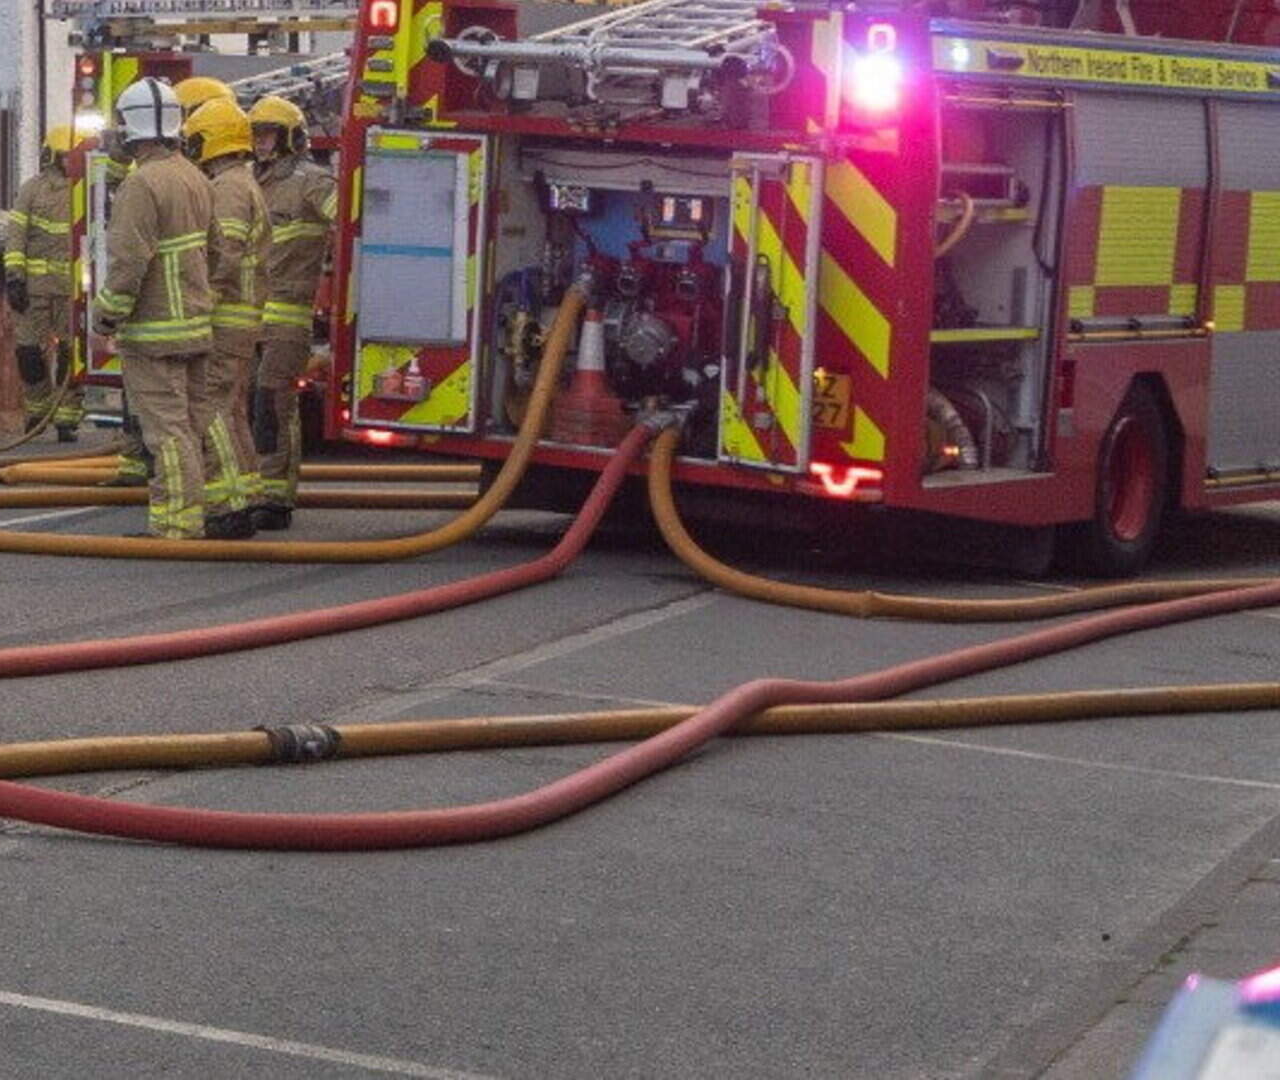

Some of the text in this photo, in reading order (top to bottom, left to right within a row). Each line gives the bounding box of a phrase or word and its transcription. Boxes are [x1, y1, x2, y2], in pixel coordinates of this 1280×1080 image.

[1027, 49, 1257, 87] Northern Ireland Fire & Rescue Service
